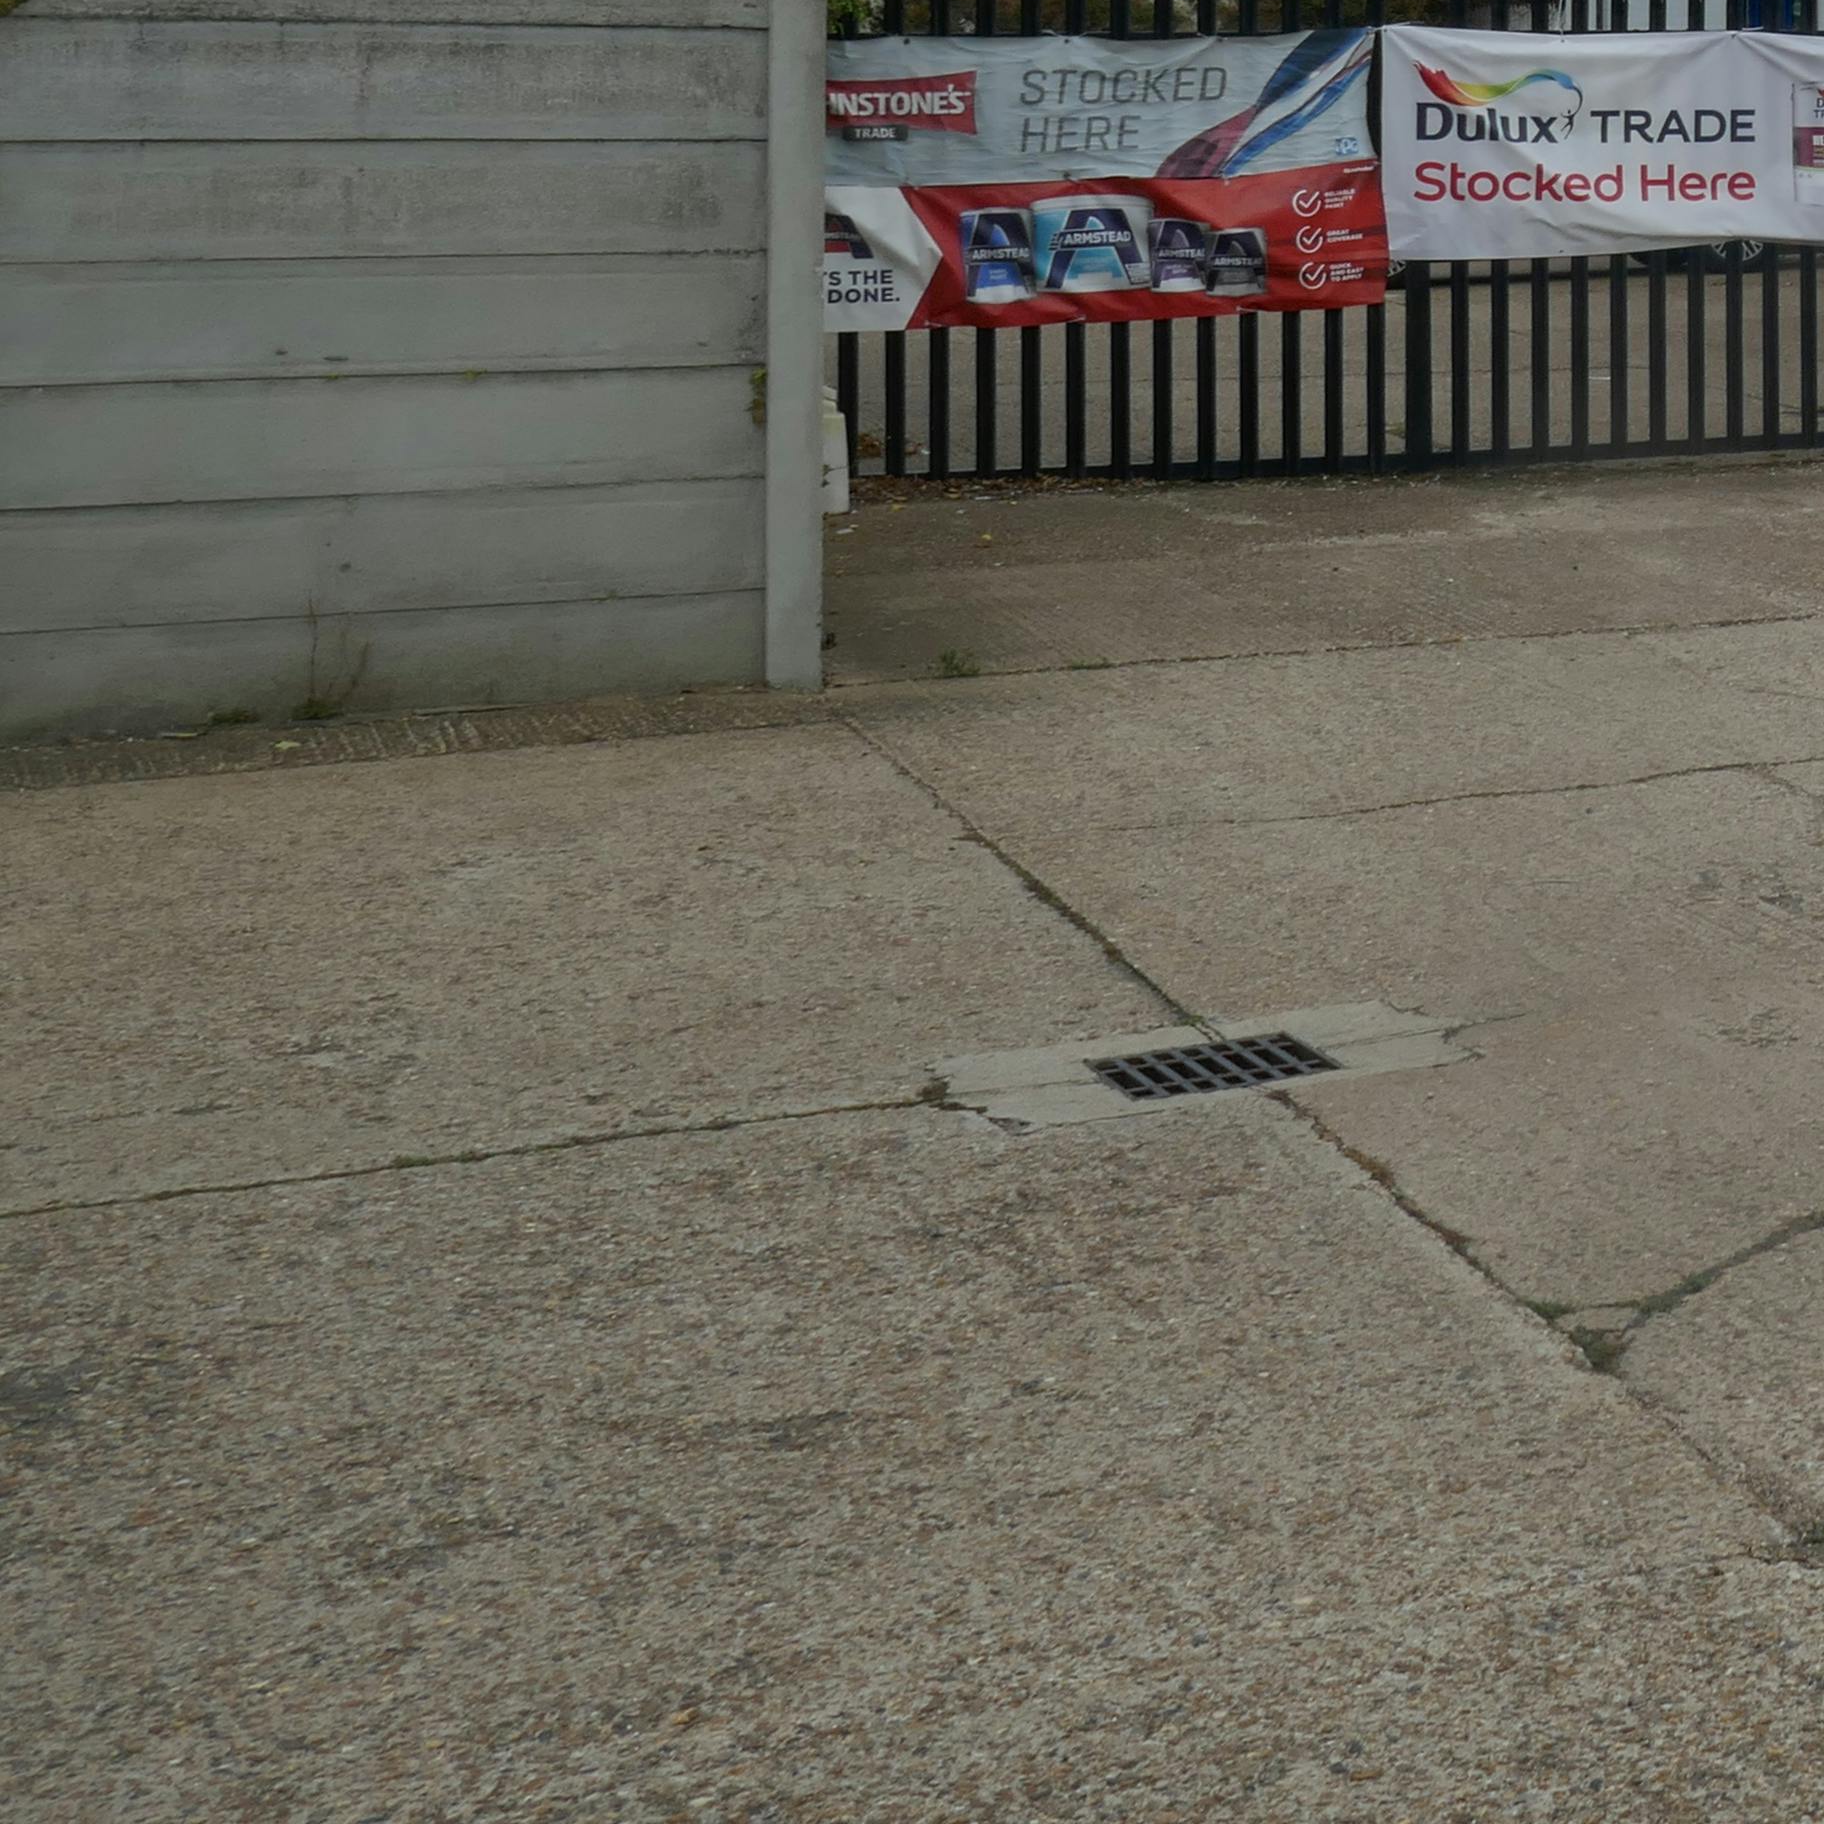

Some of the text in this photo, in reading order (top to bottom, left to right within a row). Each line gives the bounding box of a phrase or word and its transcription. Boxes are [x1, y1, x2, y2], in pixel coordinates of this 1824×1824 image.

[1020, 67, 1227, 106] STOCKED
[854, 127, 896, 138] TRADE
[1020, 115, 1140, 153] HERE
[1416, 102, 1756, 143] Dulux TRADE
[1414, 162, 1756, 202] Stocked Here
[1064, 231, 1131, 244] ARMSTEAD
[848, 270, 893, 285] THE
[827, 288, 900, 304] DONE.
